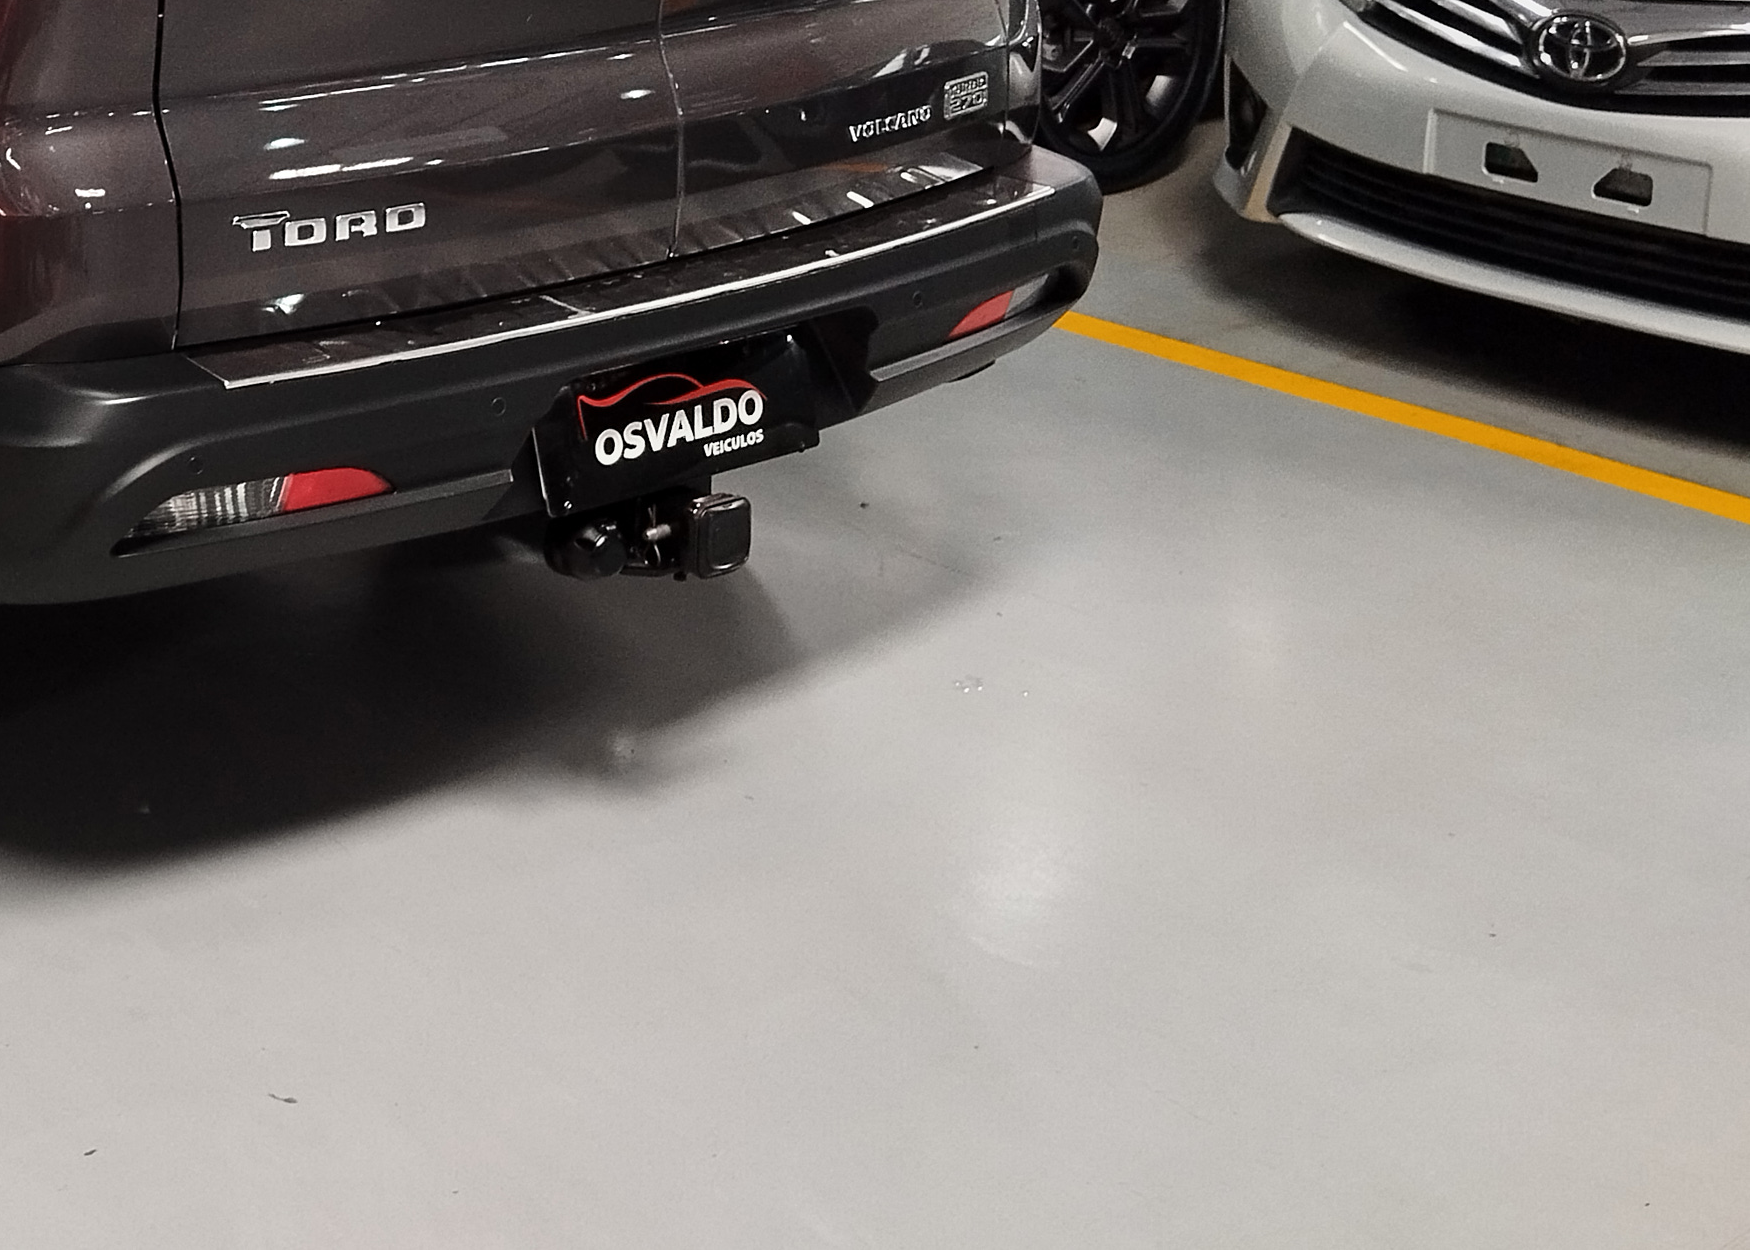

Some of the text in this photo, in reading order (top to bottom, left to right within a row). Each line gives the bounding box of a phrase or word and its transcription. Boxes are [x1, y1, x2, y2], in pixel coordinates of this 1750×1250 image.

[949, 90, 983, 112] 270
[848, 104, 933, 143] VOLCANO
[232, 202, 426, 252] TORO
[594, 389, 765, 466] OSVALDO
[703, 428, 765, 458] VEICULOS
